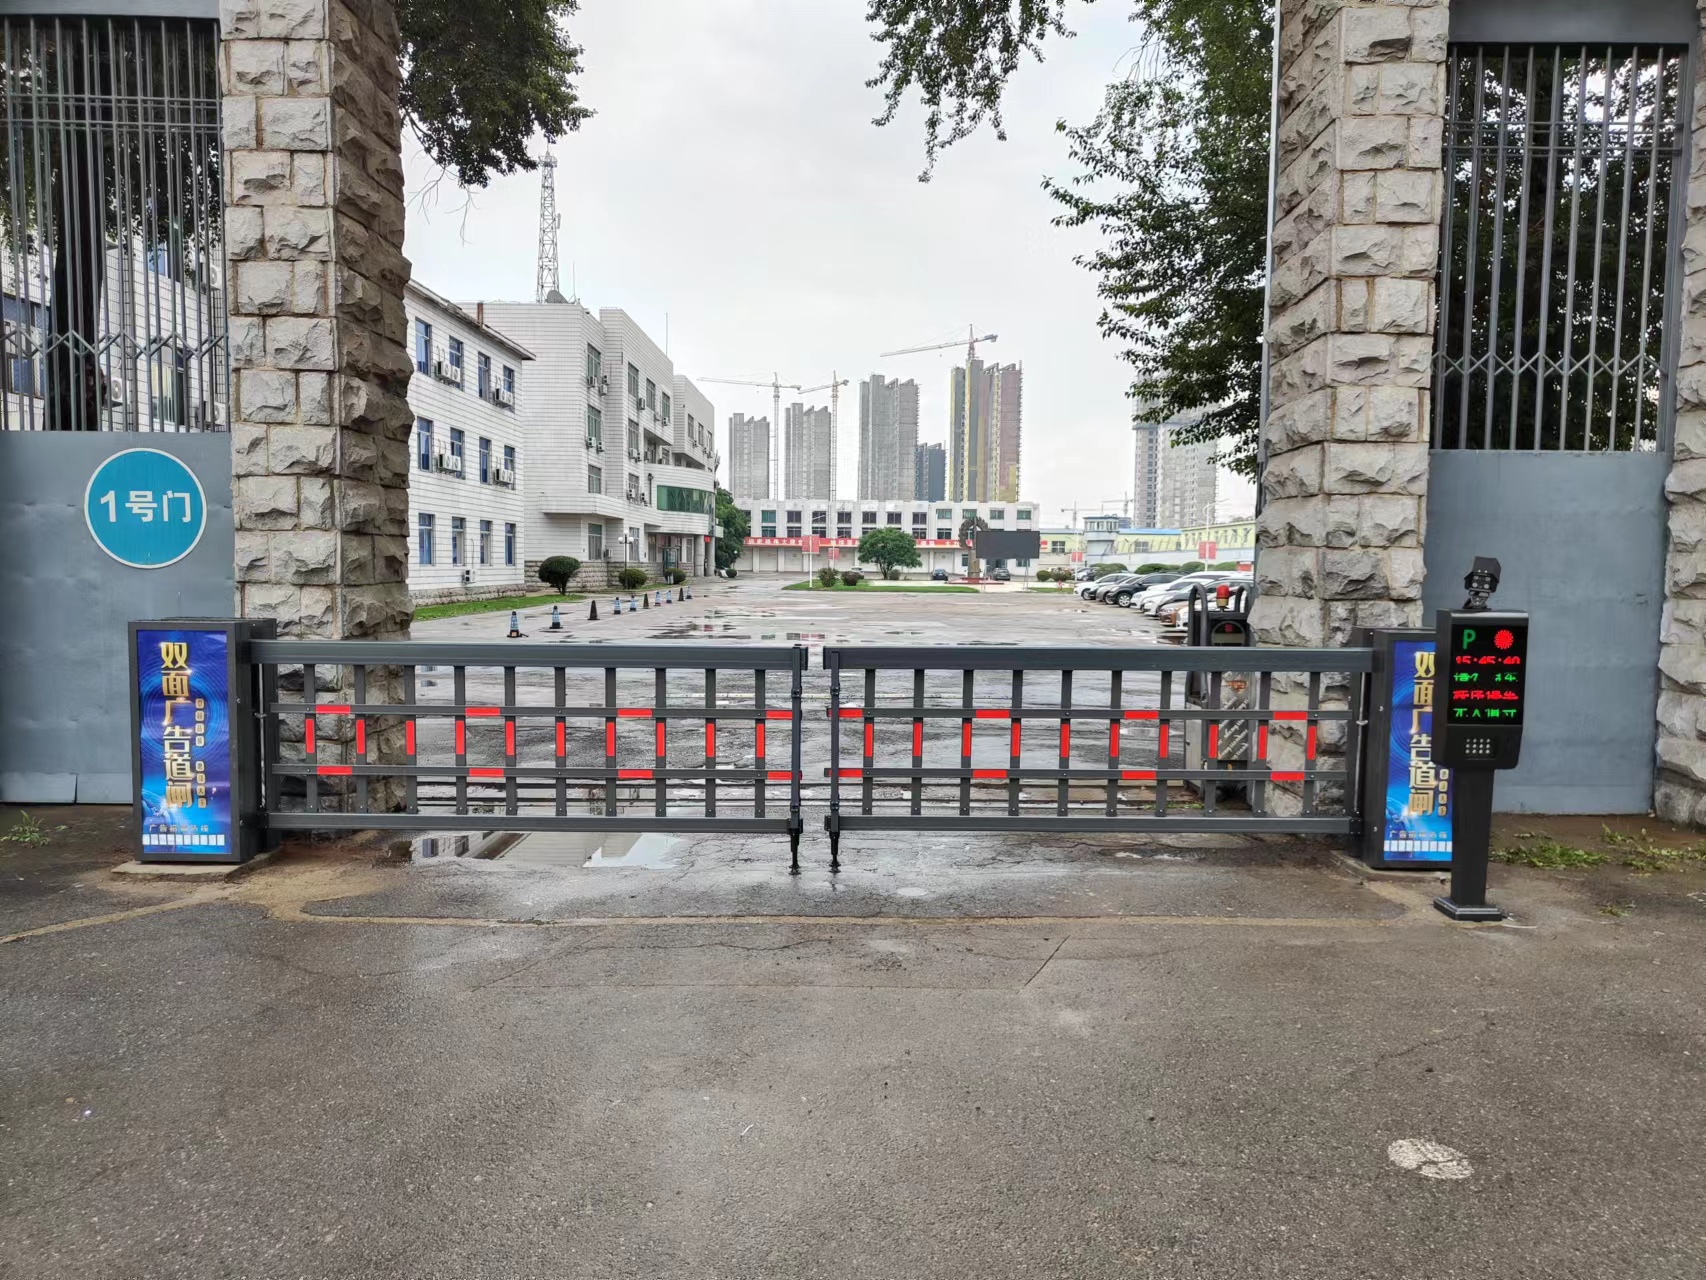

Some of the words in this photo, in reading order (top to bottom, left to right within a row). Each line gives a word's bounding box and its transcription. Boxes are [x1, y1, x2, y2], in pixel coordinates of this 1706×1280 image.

[99, 490, 192, 524] 1号门
[1462, 629, 1476, 650] P
[159, 641, 194, 809] 双面广告道闸
